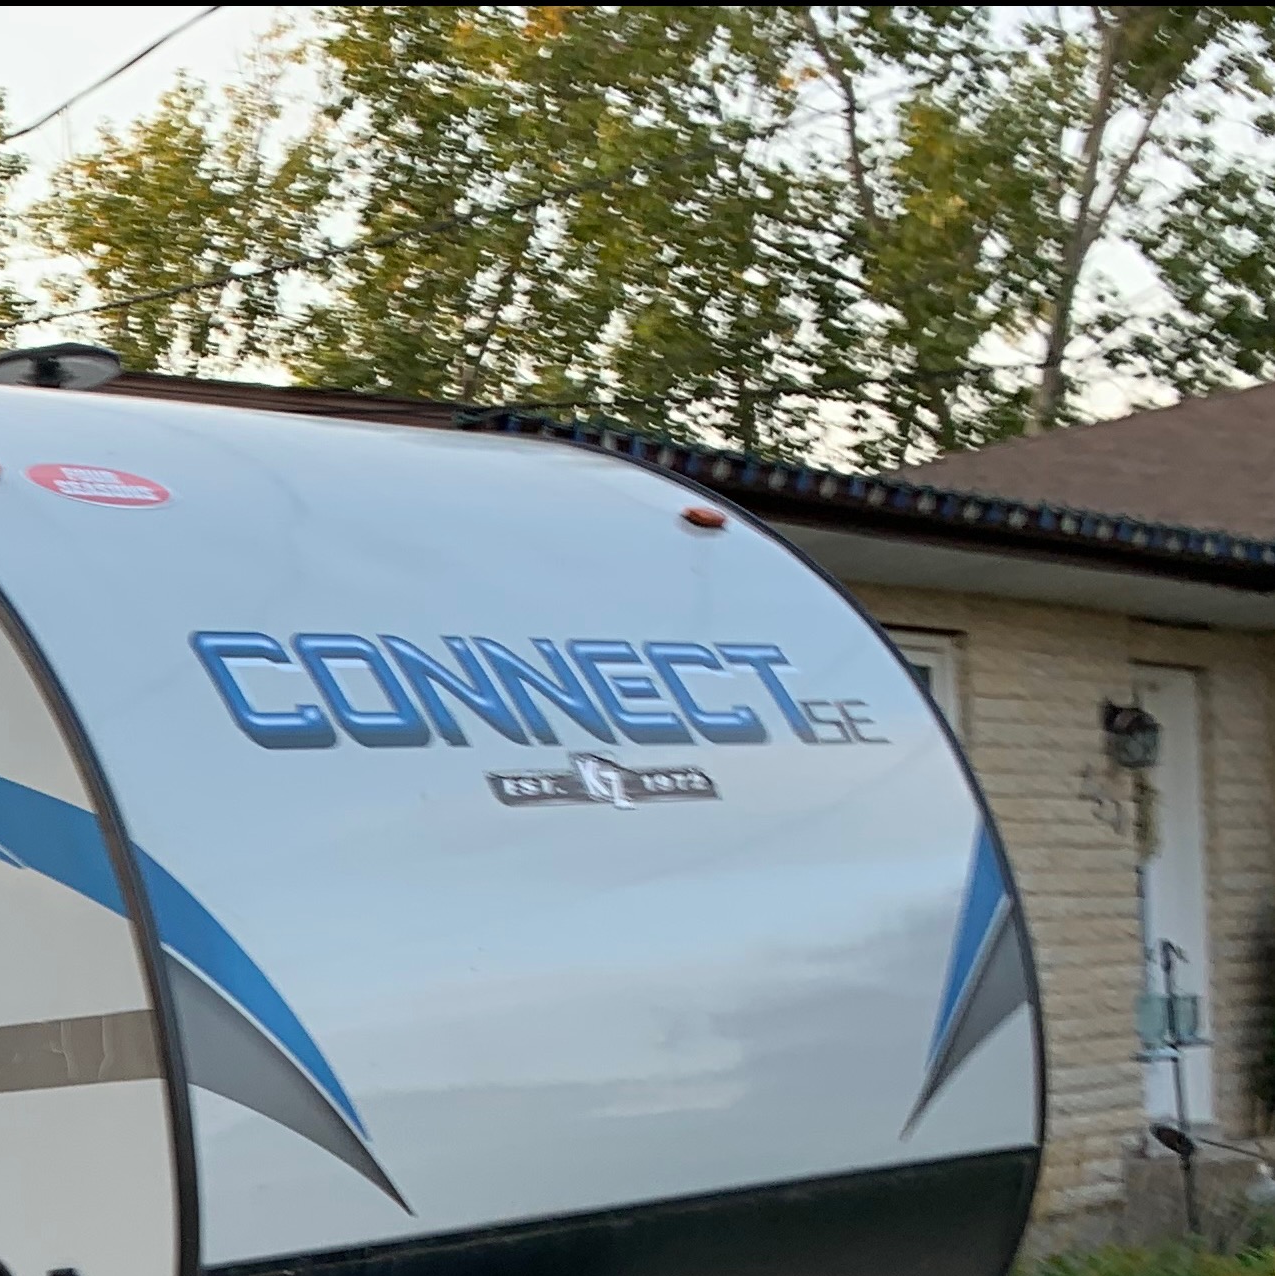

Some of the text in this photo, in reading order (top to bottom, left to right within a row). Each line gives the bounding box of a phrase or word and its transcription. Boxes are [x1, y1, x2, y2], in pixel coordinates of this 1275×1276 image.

[53, 479, 160, 501] SEASONS
[189, 631, 894, 749] CONNECT SE
